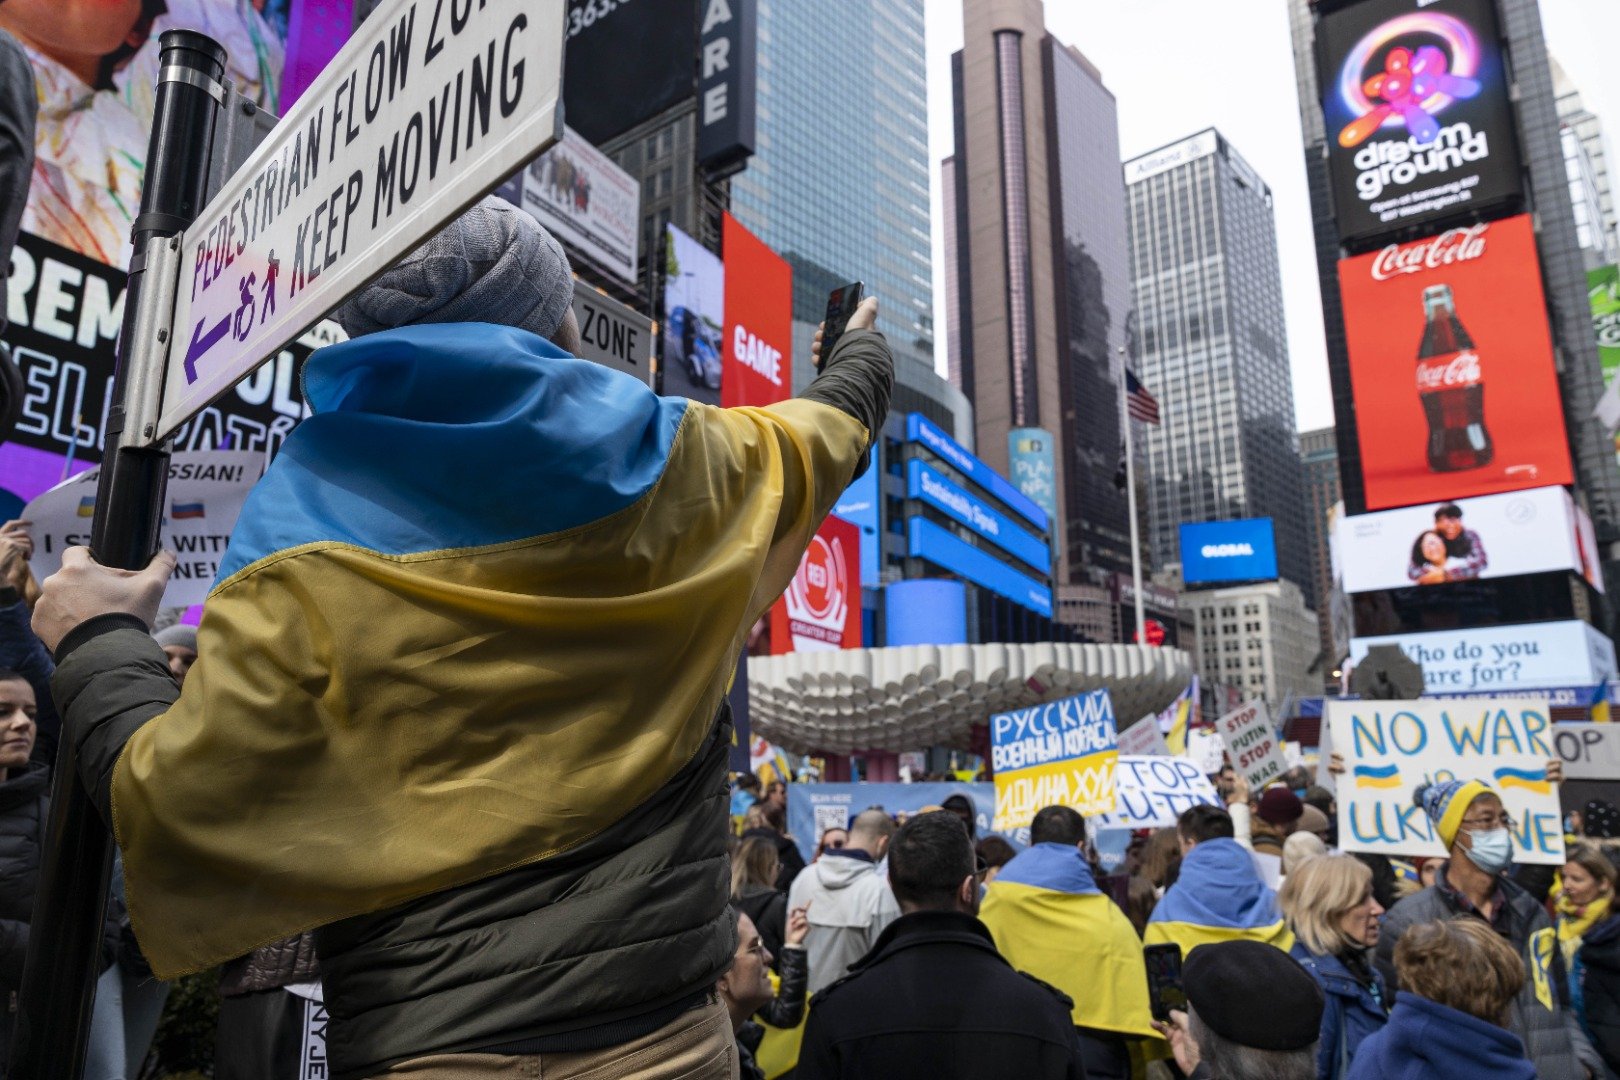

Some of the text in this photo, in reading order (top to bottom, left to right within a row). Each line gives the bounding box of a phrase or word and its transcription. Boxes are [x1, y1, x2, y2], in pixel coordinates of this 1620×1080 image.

[191, 0, 488, 303] PEDESTRIAN FLOW ZO
[289, 169, 364, 299] KEEP
[371, 13, 529, 231] MOVING
[1356, 130, 1489, 200] ground
[581, 304, 639, 366] ZONE
[733, 323, 783, 388] GAME
[168, 463, 244, 482] SSIAN!
[1404, 641, 1540, 668] ho do you
[1421, 661, 1522, 688] are for?
[994, 689, 1113, 743] РУССКИЙ
[1226, 707, 1257, 733] STOP
[1230, 723, 1267, 752] PUTIN
[1351, 708, 1553, 758] NO WAR
[1555, 729, 1604, 763] OP
[1239, 740, 1272, 769] STOP
[1118, 760, 1199, 790] TOP
[1248, 760, 1279, 785] WAR
